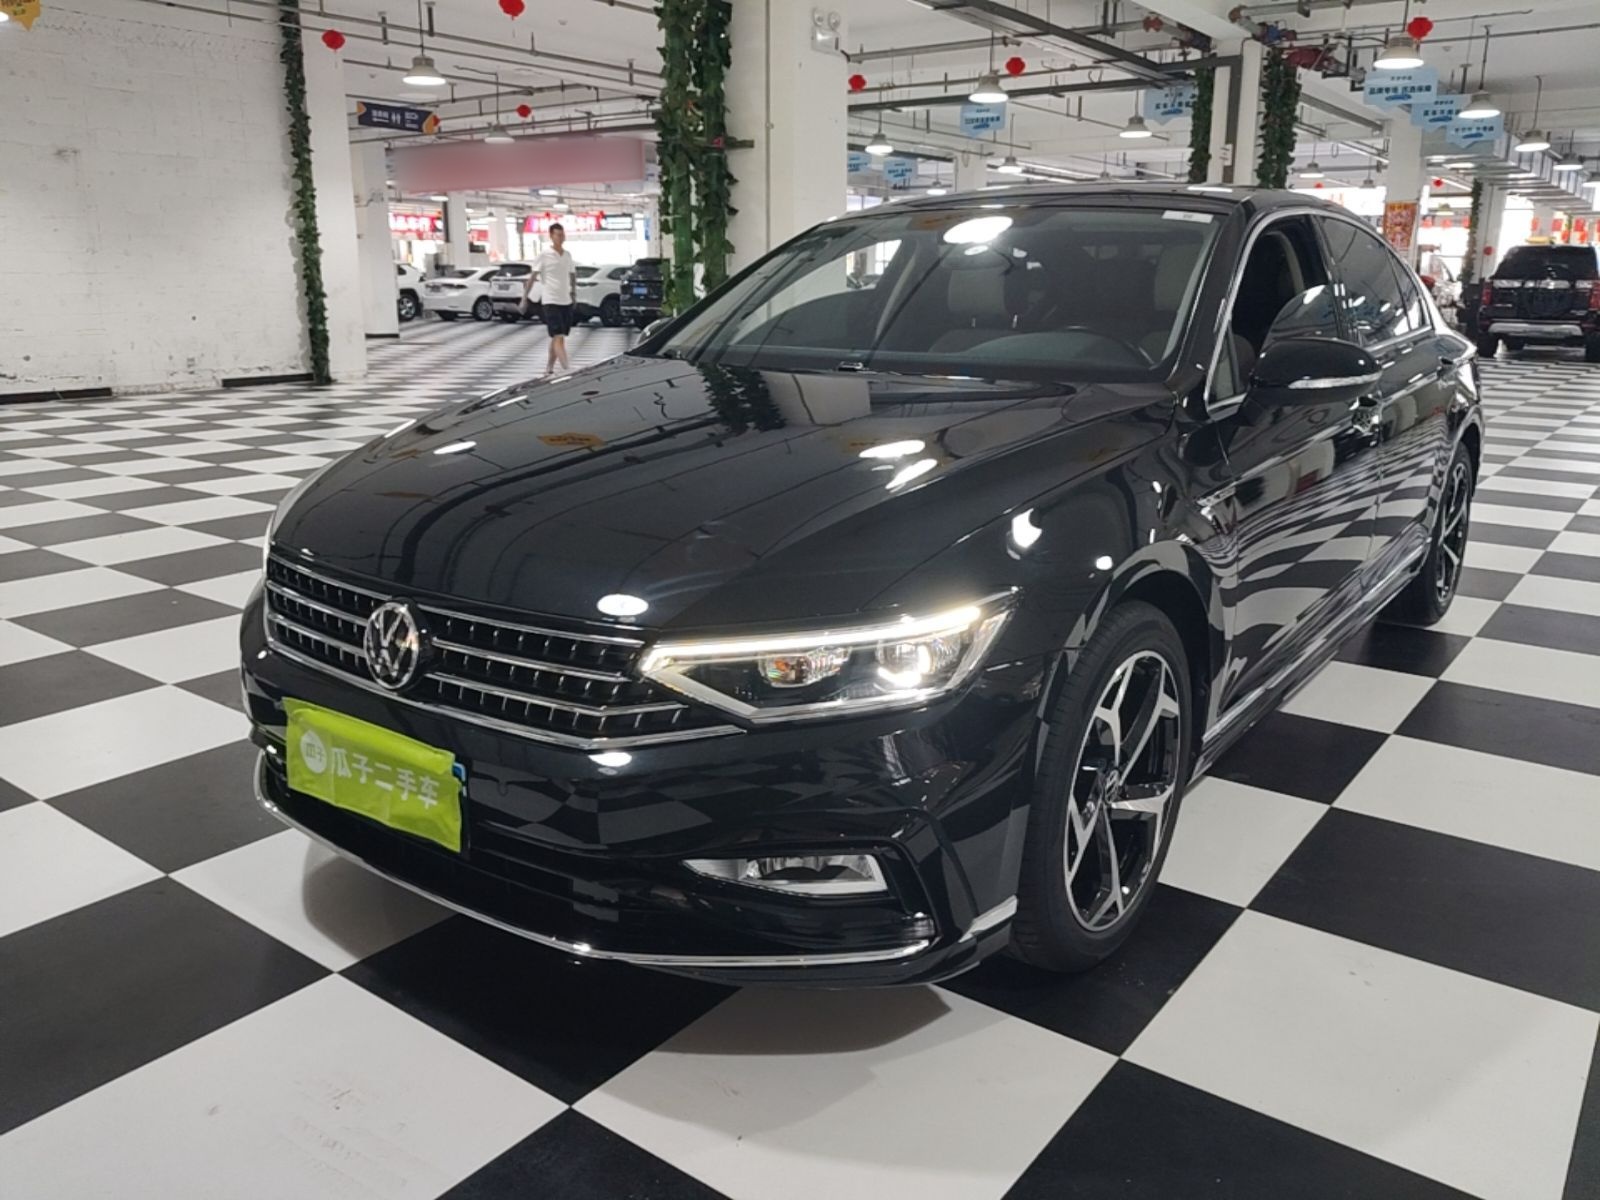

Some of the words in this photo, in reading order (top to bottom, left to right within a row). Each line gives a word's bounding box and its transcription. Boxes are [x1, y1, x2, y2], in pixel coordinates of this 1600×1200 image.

[331, 747, 440, 810] 瓜子二手车
